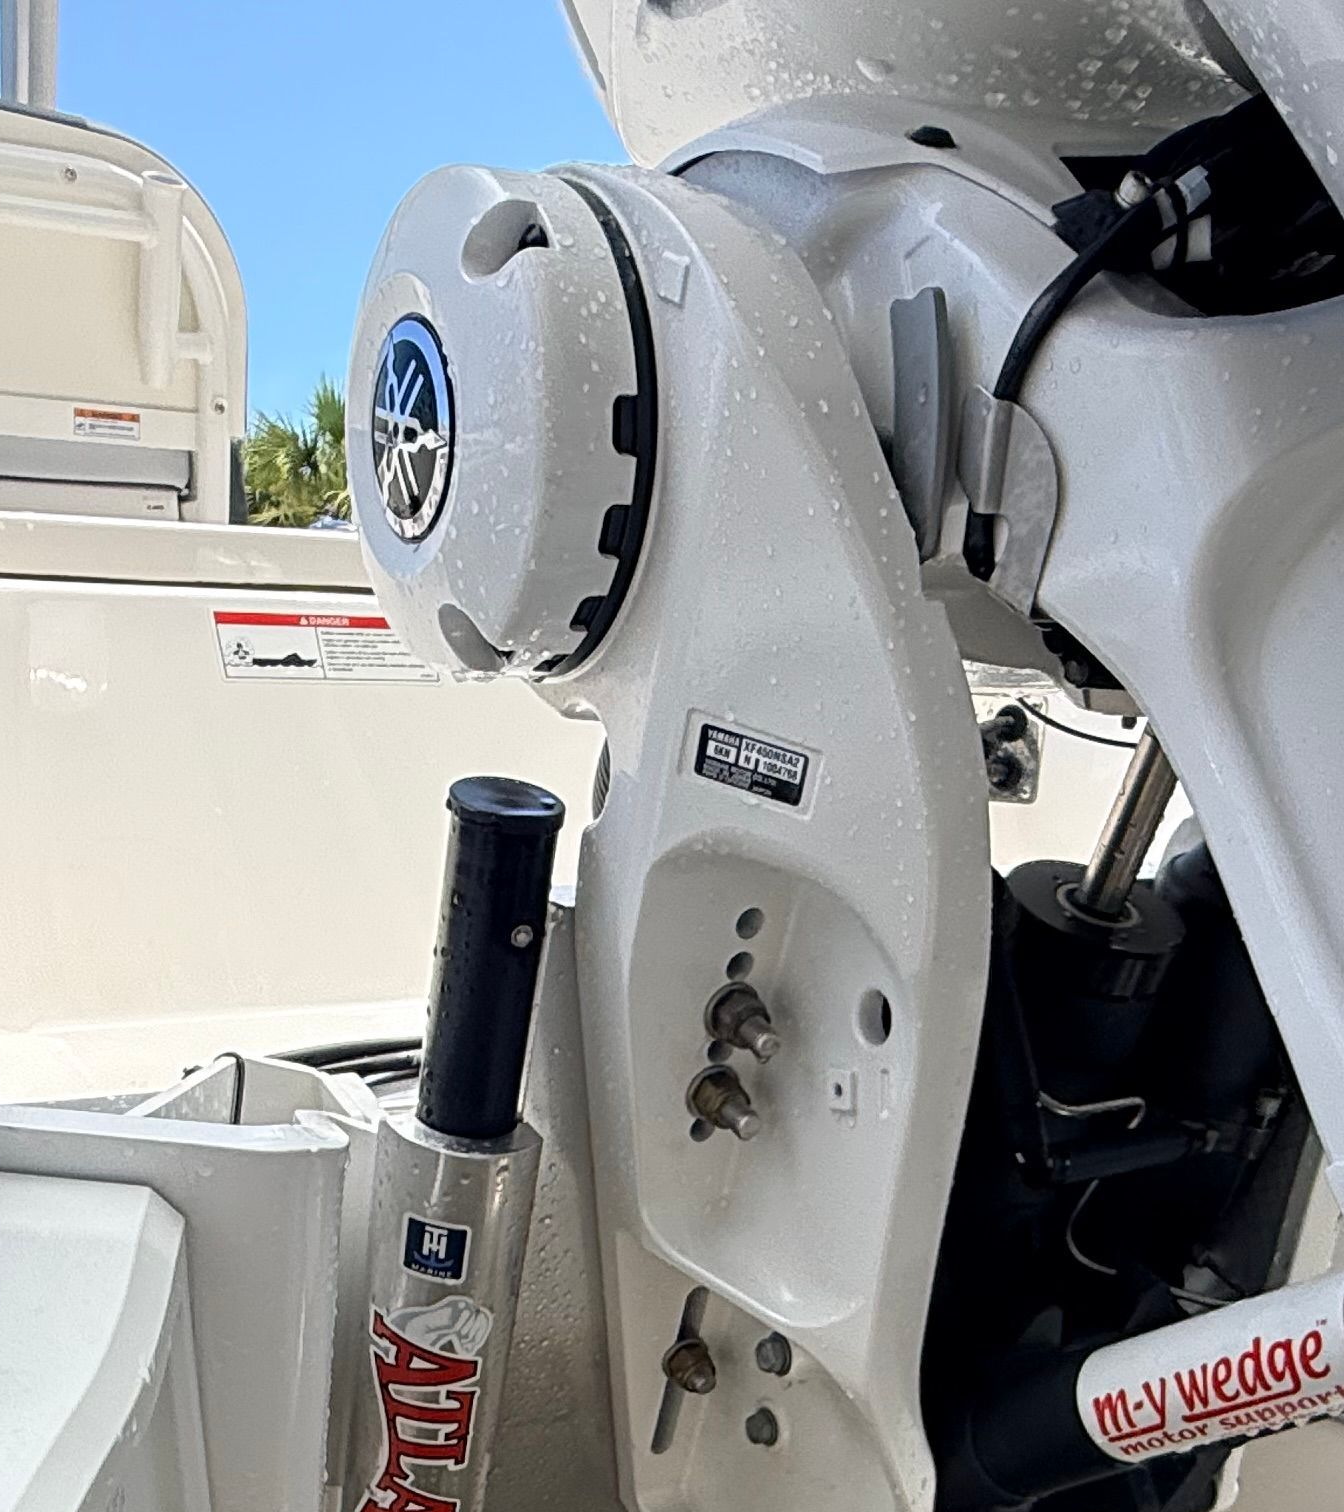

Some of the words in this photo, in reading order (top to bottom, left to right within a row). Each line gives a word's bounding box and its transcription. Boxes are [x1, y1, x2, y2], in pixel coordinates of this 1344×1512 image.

[308, 616, 350, 626] DANGER
[708, 729, 740, 747] YAMAHA
[411, 1263, 453, 1279] MARINE
[1173, 1329, 1331, 1424] wedge
[1120, 1422, 1209, 1456] motor
